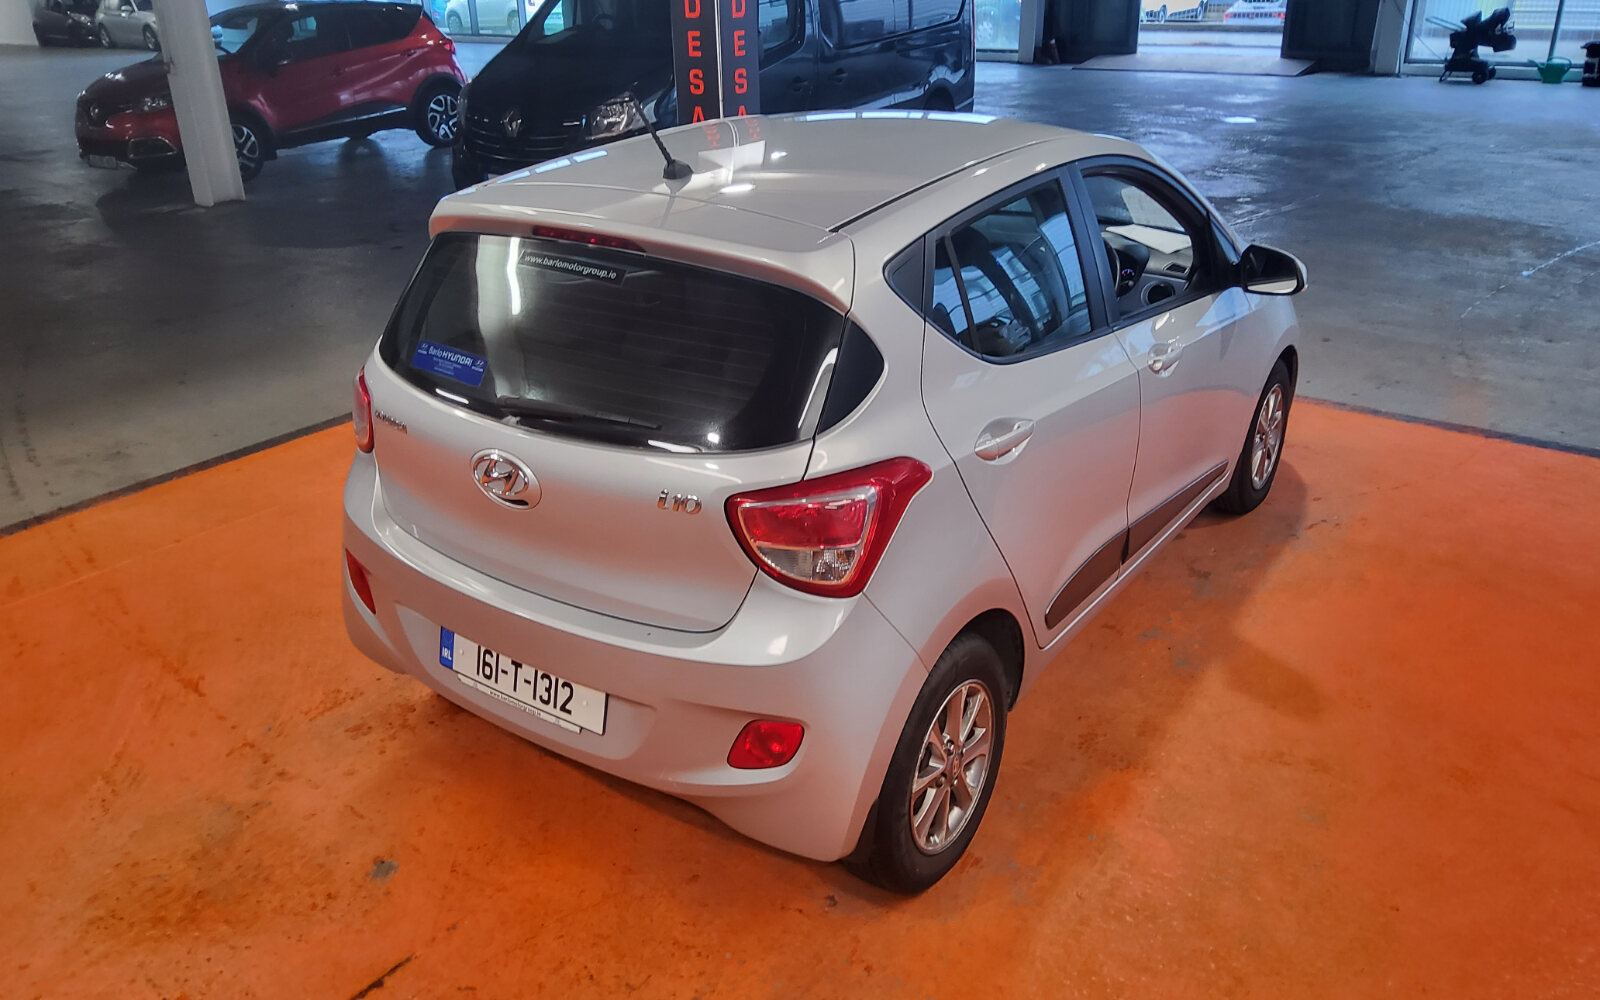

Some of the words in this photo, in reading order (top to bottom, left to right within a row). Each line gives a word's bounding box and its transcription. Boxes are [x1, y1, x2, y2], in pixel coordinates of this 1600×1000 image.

[524, 254, 617, 280] www.barlomotorgroup.ie
[657, 489, 702, 515] i10
[442, 646, 452, 660] IRL
[476, 645, 574, 716] 161-T-1312
